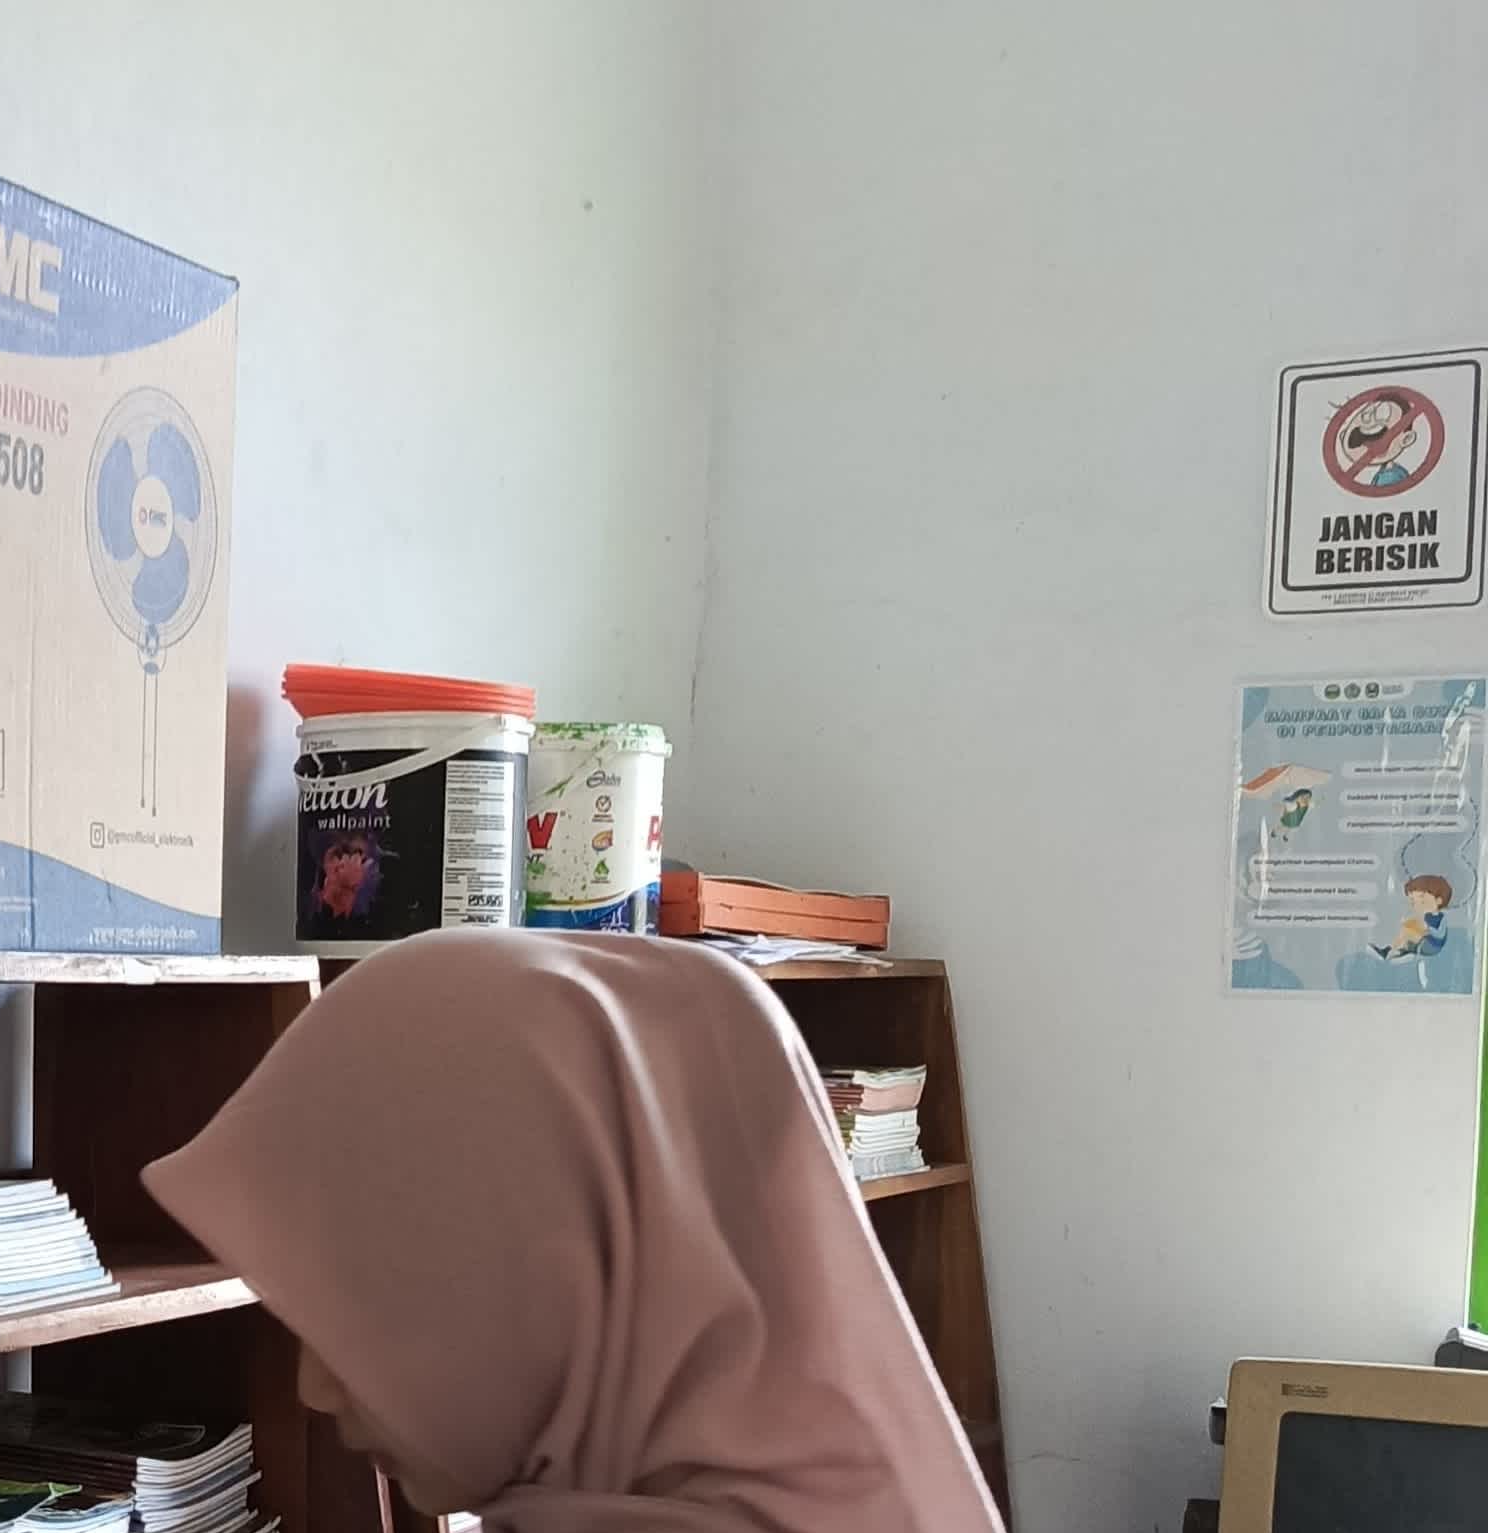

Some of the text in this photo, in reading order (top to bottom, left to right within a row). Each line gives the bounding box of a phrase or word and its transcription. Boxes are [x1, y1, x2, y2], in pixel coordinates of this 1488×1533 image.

[1319, 509, 1438, 543] JANGAN
[1315, 541, 1440, 575] BERISIK
[317, 812, 392, 831] wallpaint
